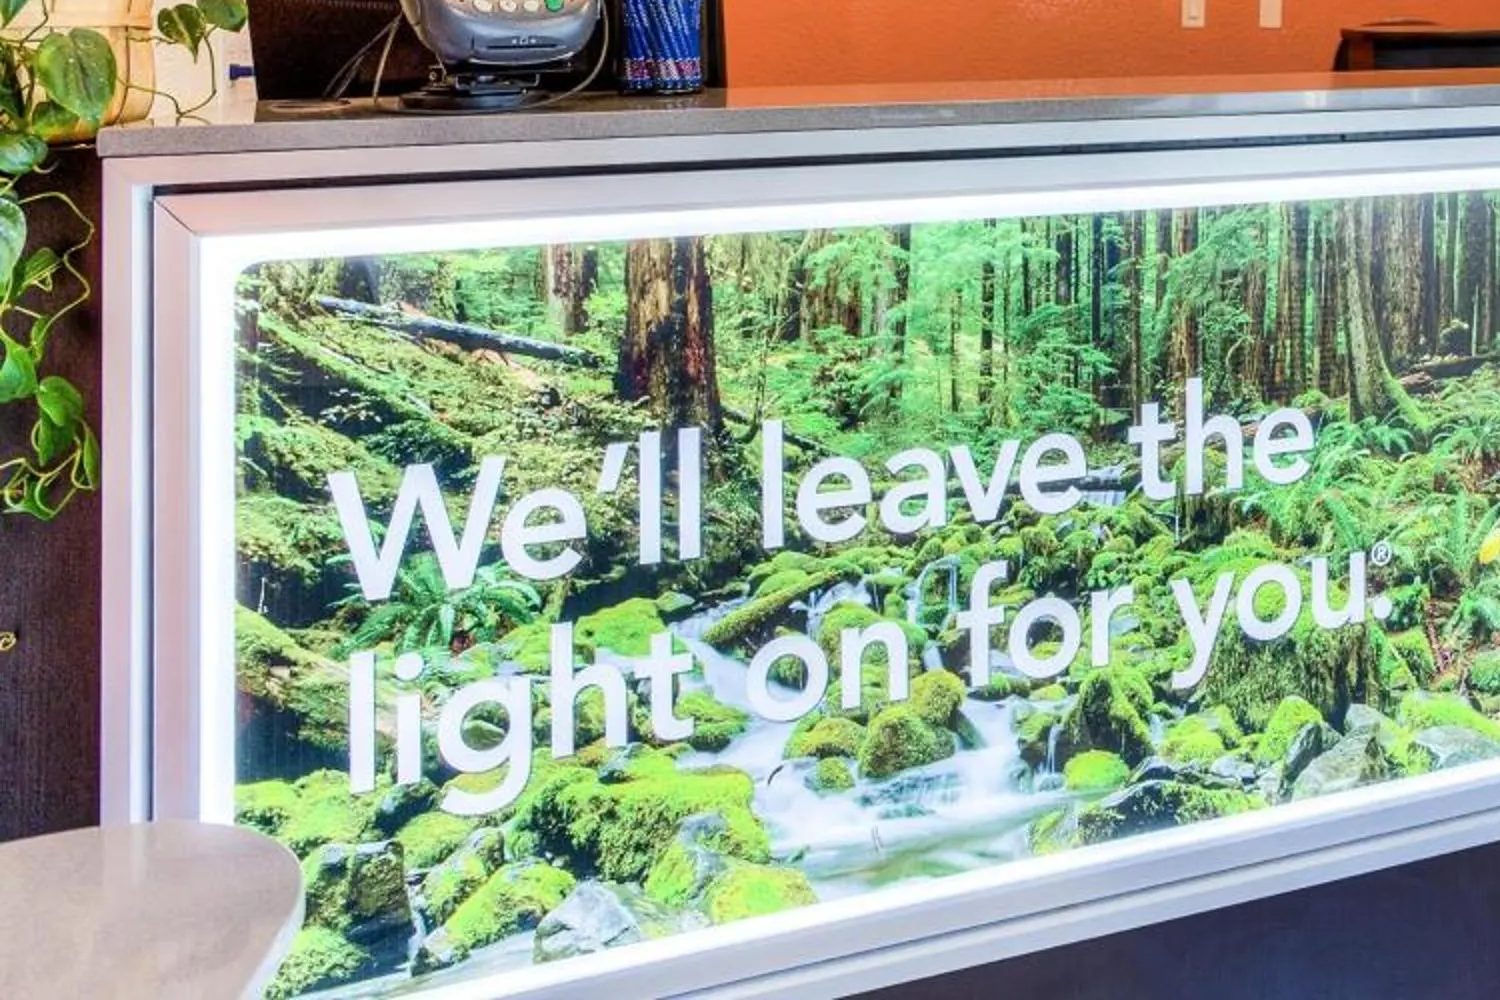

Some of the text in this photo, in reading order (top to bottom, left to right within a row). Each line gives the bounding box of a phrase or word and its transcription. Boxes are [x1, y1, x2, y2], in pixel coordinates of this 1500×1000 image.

[327, 377, 1315, 604] We'll leave the
[348, 622, 696, 818] light
[747, 617, 909, 726] on
[959, 560, 1138, 689] for
